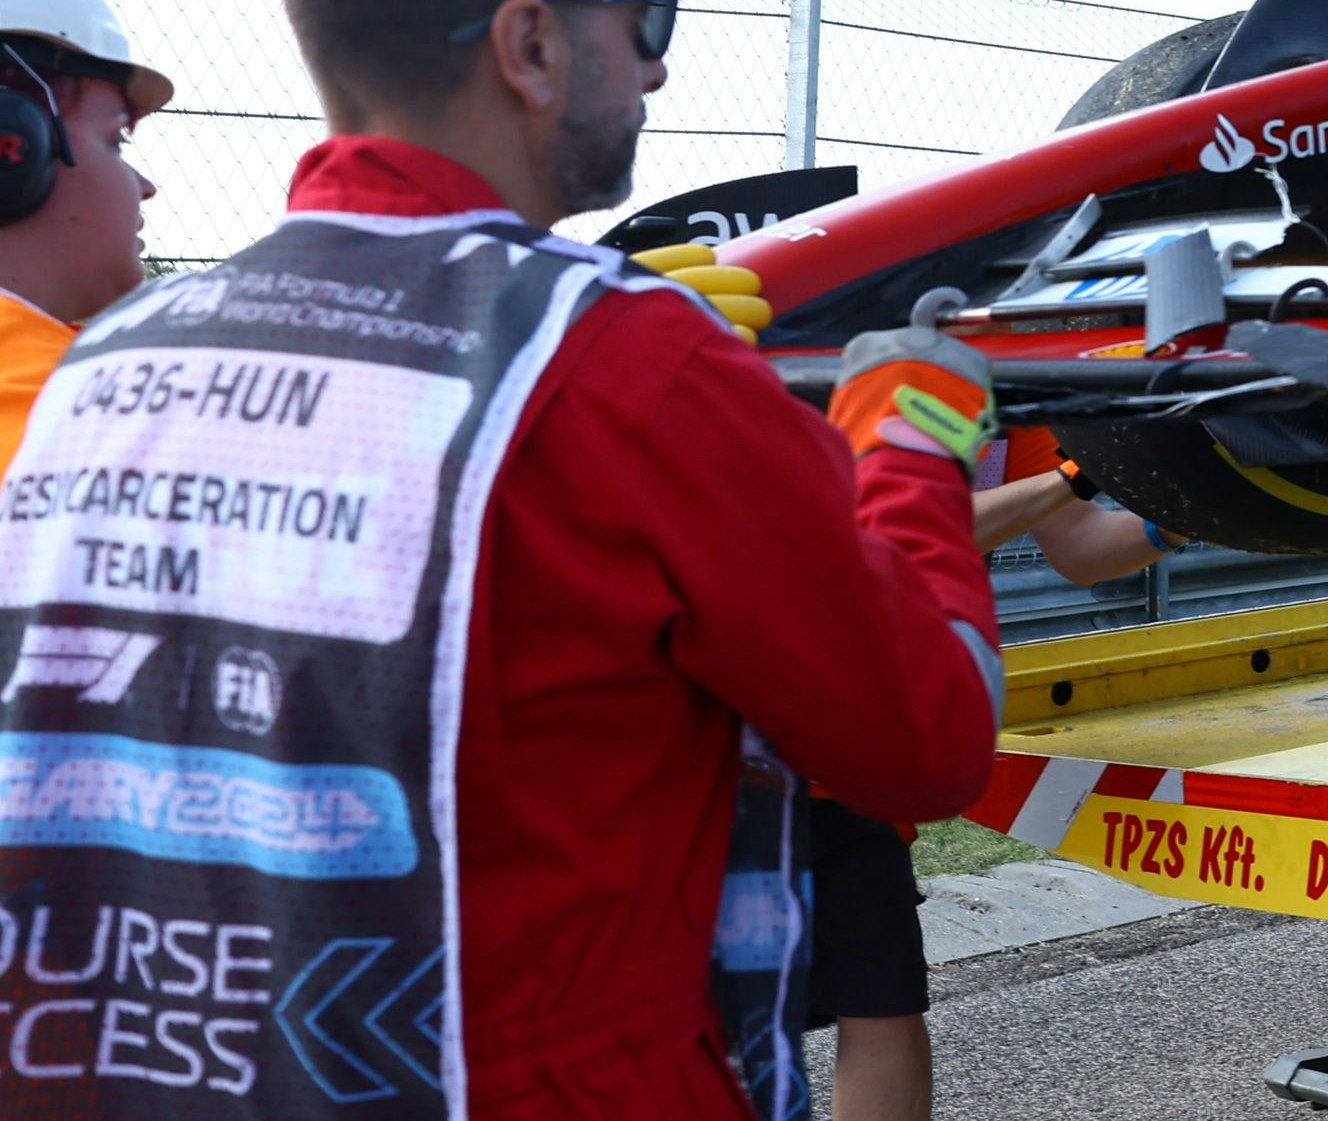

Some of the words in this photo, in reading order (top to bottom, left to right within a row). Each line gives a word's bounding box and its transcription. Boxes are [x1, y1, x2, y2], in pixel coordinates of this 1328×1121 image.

[73, 362, 331, 428] 0436-HUN
[75, 537, 203, 596] TEAM
[1101, 810, 1187, 880] TPZS
[1198, 824, 1264, 892] Kft.
